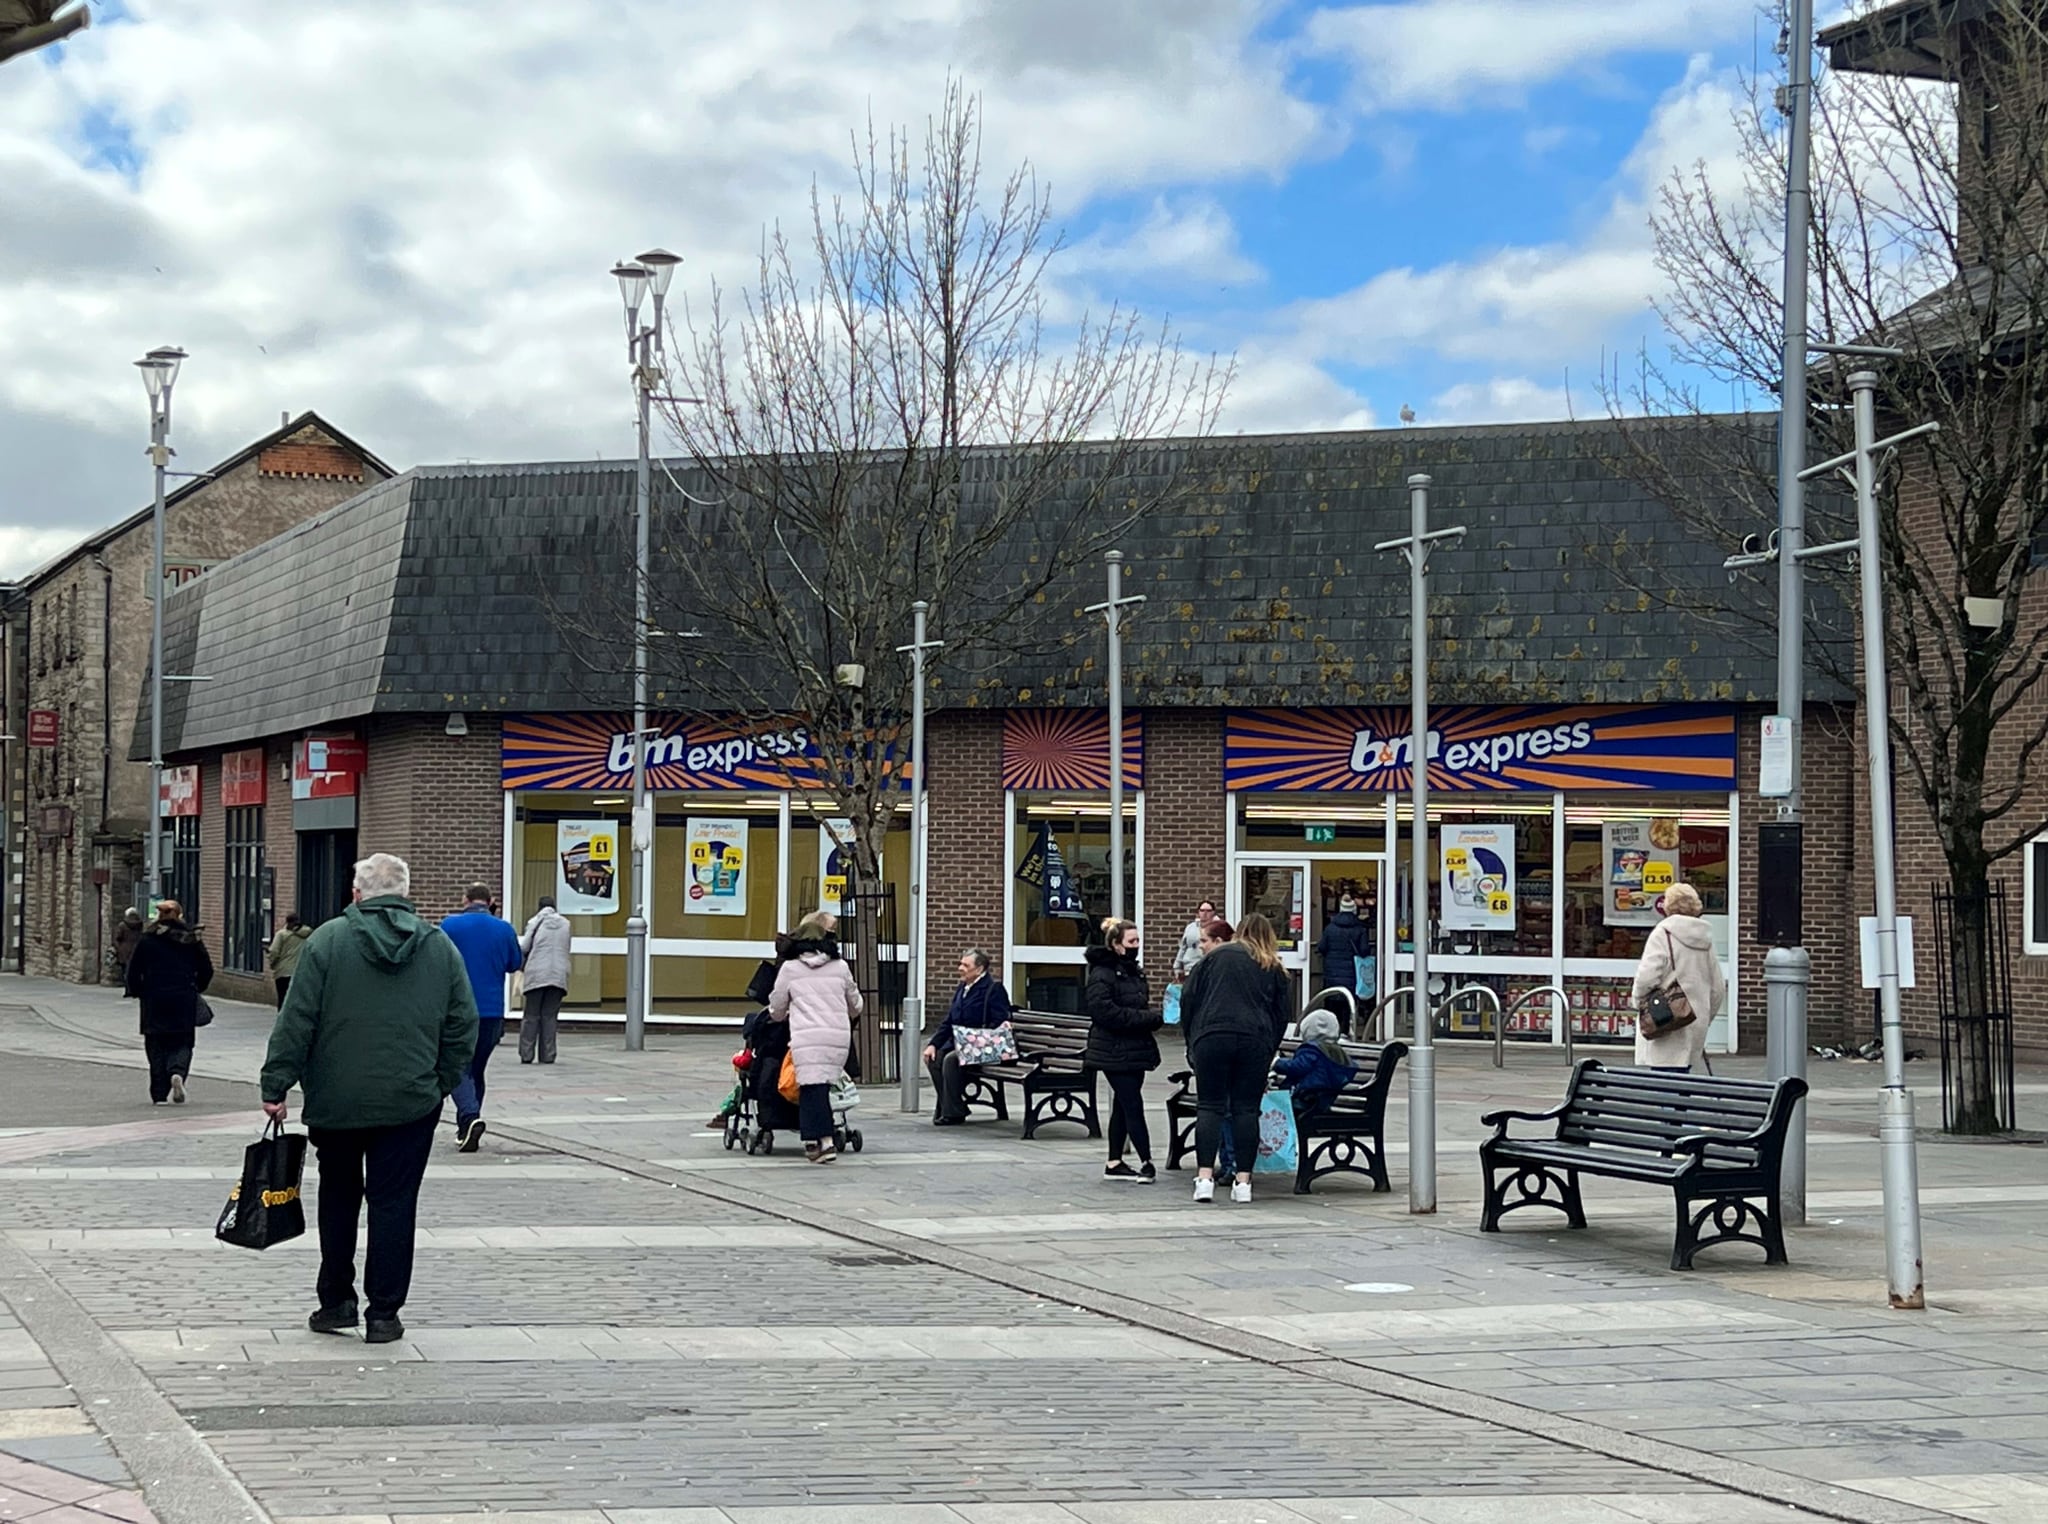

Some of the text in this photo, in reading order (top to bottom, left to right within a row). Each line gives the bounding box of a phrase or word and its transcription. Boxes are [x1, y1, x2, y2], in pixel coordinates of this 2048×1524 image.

[687, 728, 807, 773] express
[1350, 722, 1590, 772] b&m express
[595, 841, 608, 853] £1
[694, 848, 705, 858] £1
[725, 856, 741, 865] 79p
[1645, 875, 1672, 884] £2.50
[825, 884, 842, 894] 79
[1492, 899, 1508, 911] £8
